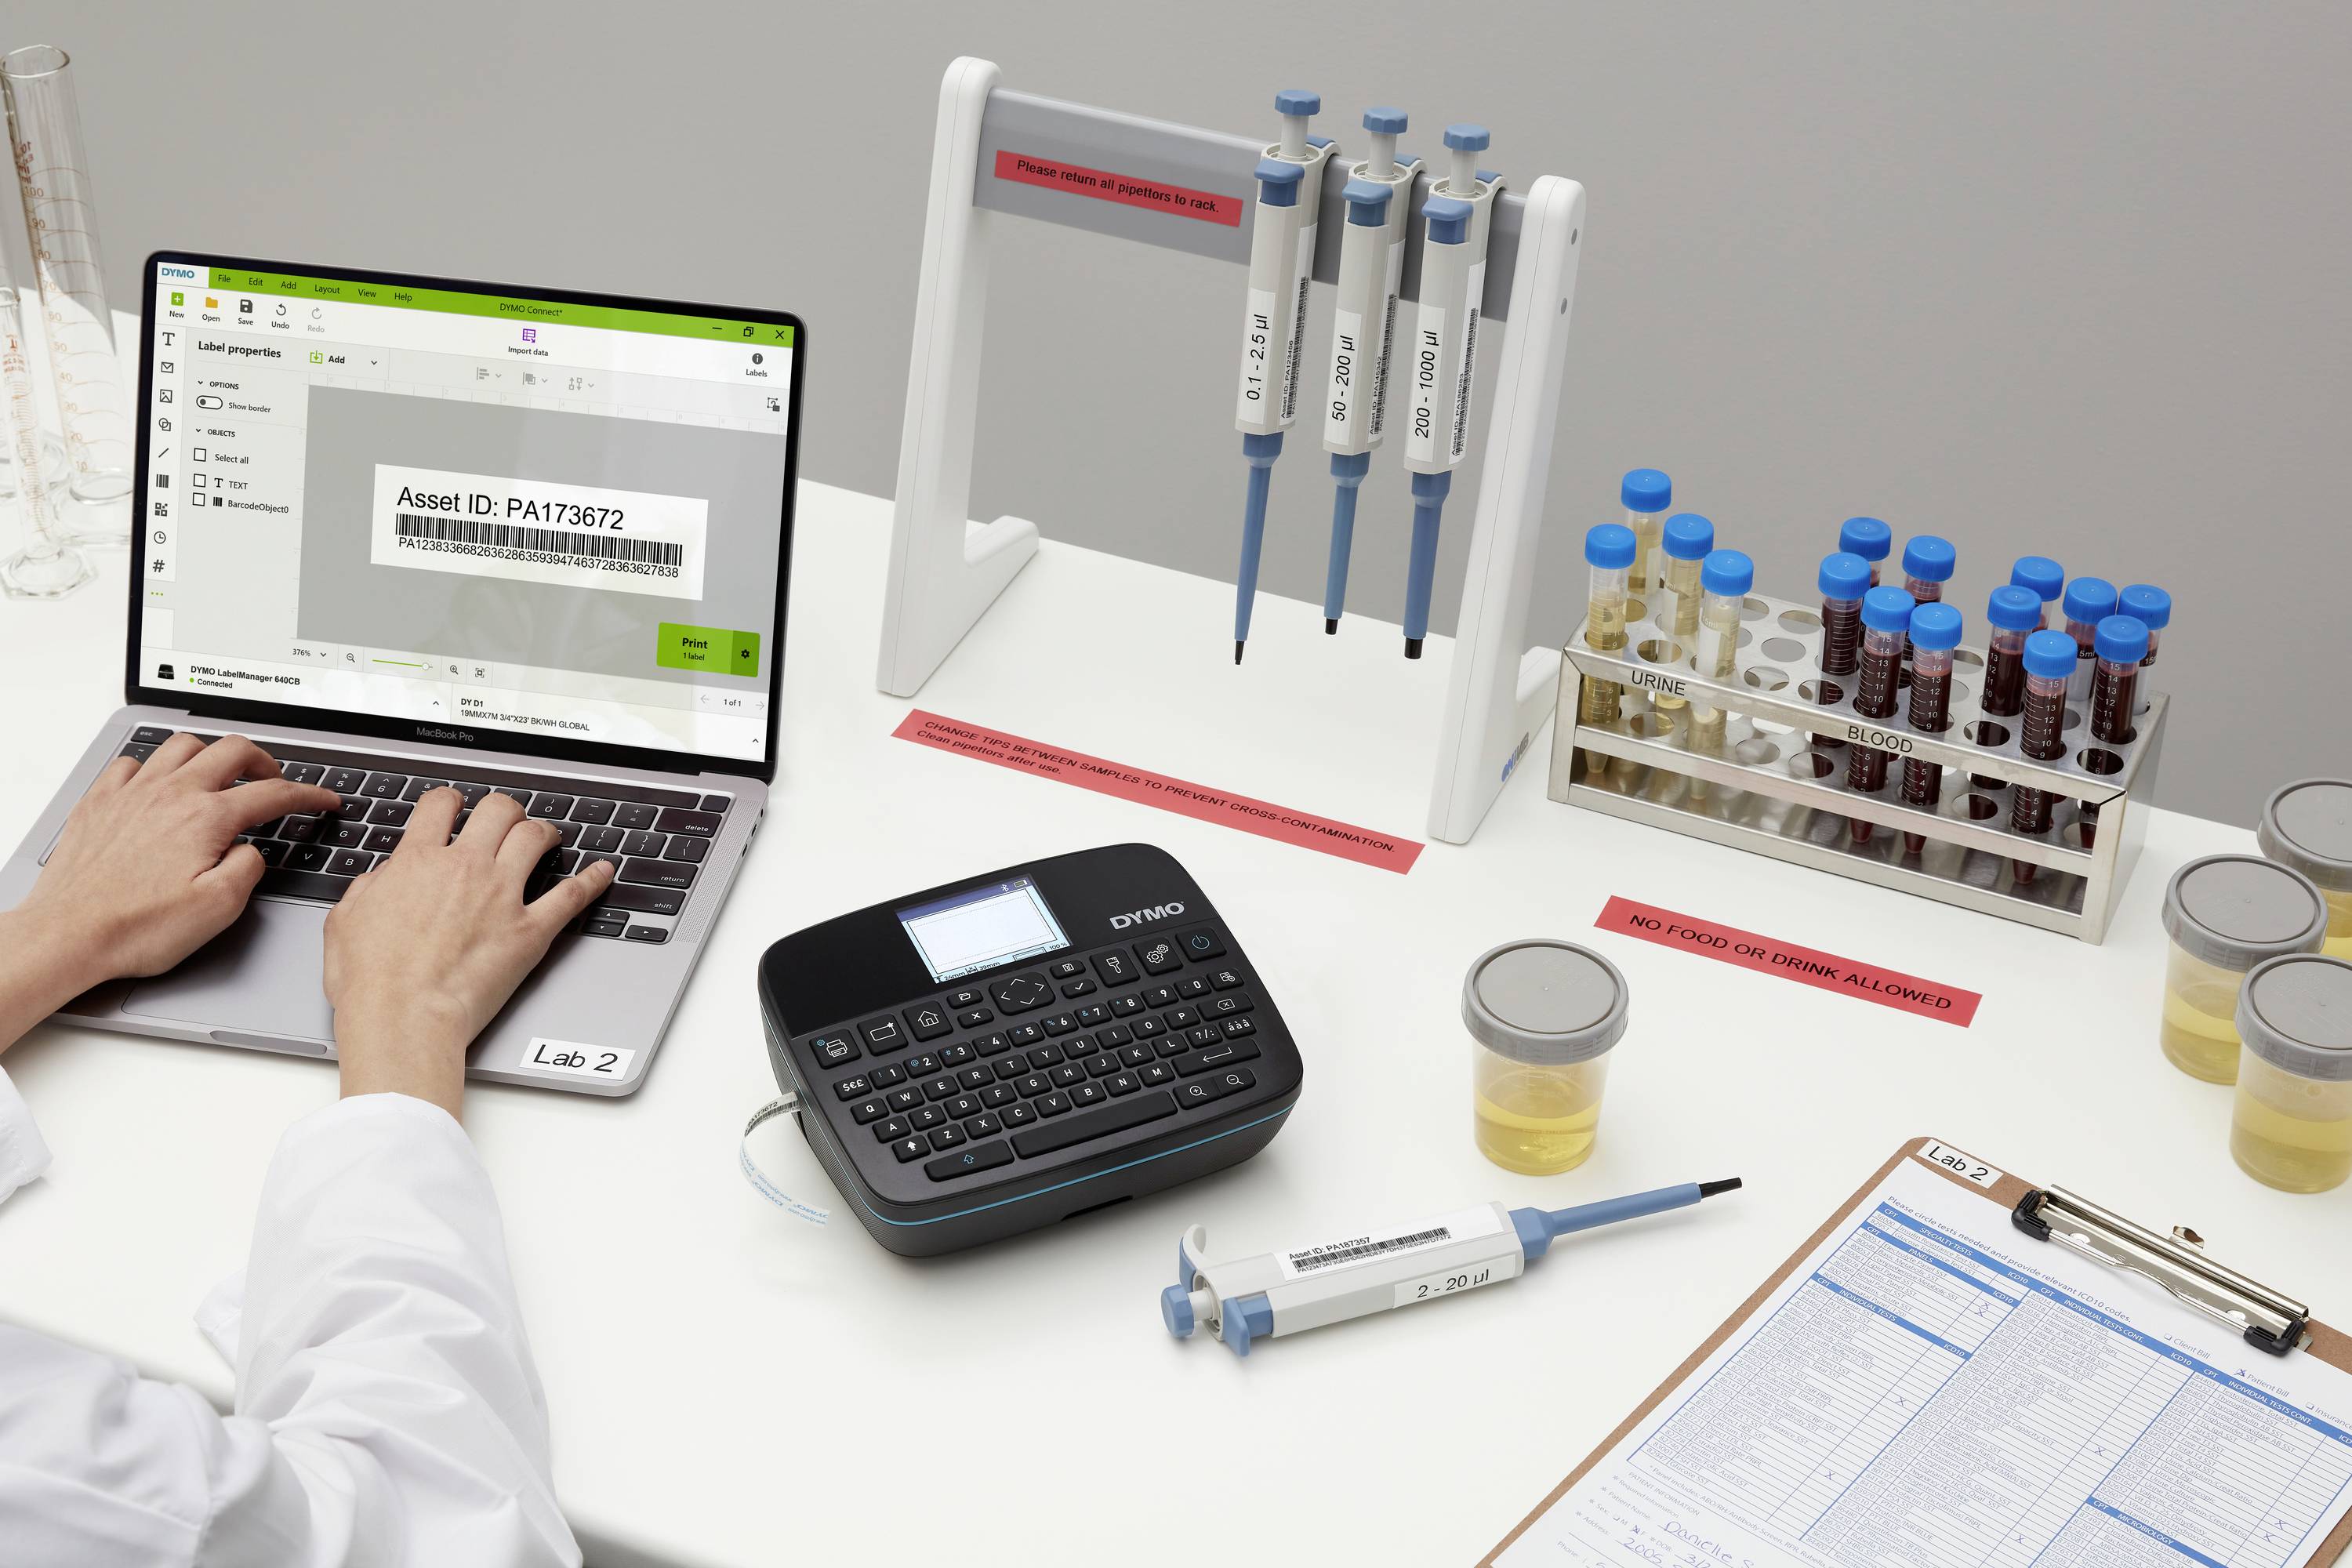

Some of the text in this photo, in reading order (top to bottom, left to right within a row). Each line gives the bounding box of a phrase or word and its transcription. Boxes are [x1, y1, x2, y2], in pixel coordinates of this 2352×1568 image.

[1018, 160, 1219, 212] Please return all pipettors to rack.
[162, 267, 194, 279] DYMO
[218, 274, 230, 284] File
[249, 278, 263, 286] Edit
[281, 281, 297, 289] Add
[314, 285, 340, 295] Layout
[358, 289, 376, 298] View
[394, 293, 412, 303] Help
[169, 310, 184, 319] New
[499, 303, 525, 314] DYMO
[202, 314, 220, 323] Open
[238, 318, 253, 326] Save
[271, 321, 289, 329] Undo
[307, 325, 325, 333] Redo
[198, 341, 281, 360] Label properties
[508, 346, 549, 357] Import data
[1250, 333, 1265, 360] 2.5
[328, 355, 345, 365] Add
[1285, 340, 1294, 380] PA123456
[746, 368, 768, 378] Labels
[1336, 355, 1351, 387] 200
[1419, 350, 1436, 390] 1000
[209, 381, 239, 390] OPTIONS
[1247, 376, 1261, 401] 0.1
[228, 402, 271, 413] Show border
[1332, 401, 1347, 421] 50
[1415, 408, 1431, 438] 200
[208, 429, 235, 437] OBJECTS
[215, 453, 238, 464] Select
[228, 481, 248, 490] TEXT
[227, 500, 289, 514] BarcodeObject0
[397, 487, 624, 530] Asset ID: PA173672
[682, 637, 708, 650] Print
[292, 648, 310, 657] 376%
[688, 652, 705, 662] label
[191, 666, 300, 685] DYMO LabelManager 640CB
[197, 678, 233, 688] Connected
[1632, 670, 1686, 696] URINE
[461, 698, 472, 706] DY
[460, 710, 498, 720] 19MMX7M
[531, 716, 557, 727] BK/WH
[558, 719, 590, 731] GLOBAL
[416, 727, 474, 742] MacBook Pro
[1848, 726, 1913, 753] BLOOD
[916, 730, 1062, 774] Clean pipettors after use.
[924, 721, 1396, 852] CHANGE TIPS BETWEEN SAMPLES TO PREVENT CROSS-CONTAMINATION.
[685, 823, 709, 833] delete
[655, 902, 673, 910] shift
[1109, 902, 1185, 930] DYMO
[1629, 914, 1952, 1010] NO FOOD OR DRINK ALLOWED
[532, 1044, 619, 1073] Lab 2
[1928, 1146, 1988, 1181] Lab 2
[1289, 1237, 1370, 1261] Asset ID: PA187357
[1919, 1228, 1973, 1256] SPECIALTY TESTS
[1888, 1196, 2132, 1324] Please circle tests needed and provide relevant ICD10 codes.
[1908, 1248, 1933, 1263] PANELS
[2007, 1272, 2028, 1284] ICD10
[1417, 1285, 1428, 1298] 2
[1446, 1275, 1468, 1291] 20
[1992, 1290, 2013, 1304] ICD10
[1840, 1290, 1896, 1323] INDIVIDUAL TESTS
[2064, 1299, 2143, 1342] INDIVIDUAL TESTS CONT.
[2174, 1338, 2211, 1359] Client Bill
[2247, 1374, 2290, 1397] Patient Bill
[2229, 1381, 2312, 1425] INDIVIDUAL TESTS CONT.
[2117, 1514, 2174, 1545] MICROBIOLOGY
